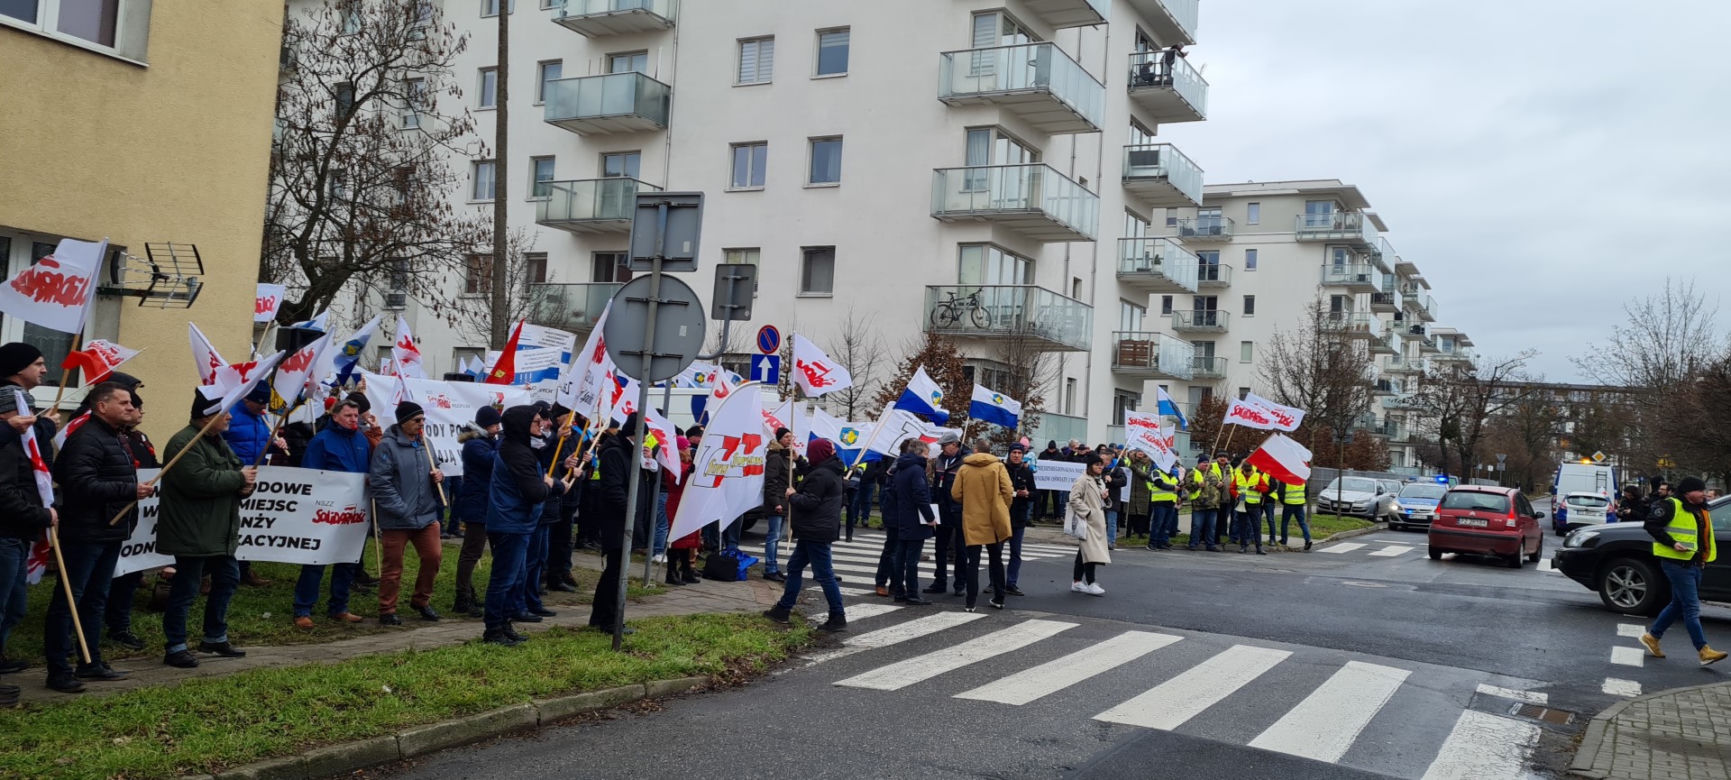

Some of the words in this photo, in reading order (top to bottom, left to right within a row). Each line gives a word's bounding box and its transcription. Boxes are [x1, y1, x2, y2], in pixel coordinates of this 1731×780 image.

[425, 424, 445, 438] ODY
[254, 481, 312, 495] DOWE
[239, 513, 276, 528] NŻY
[121, 541, 156, 557] ODN
